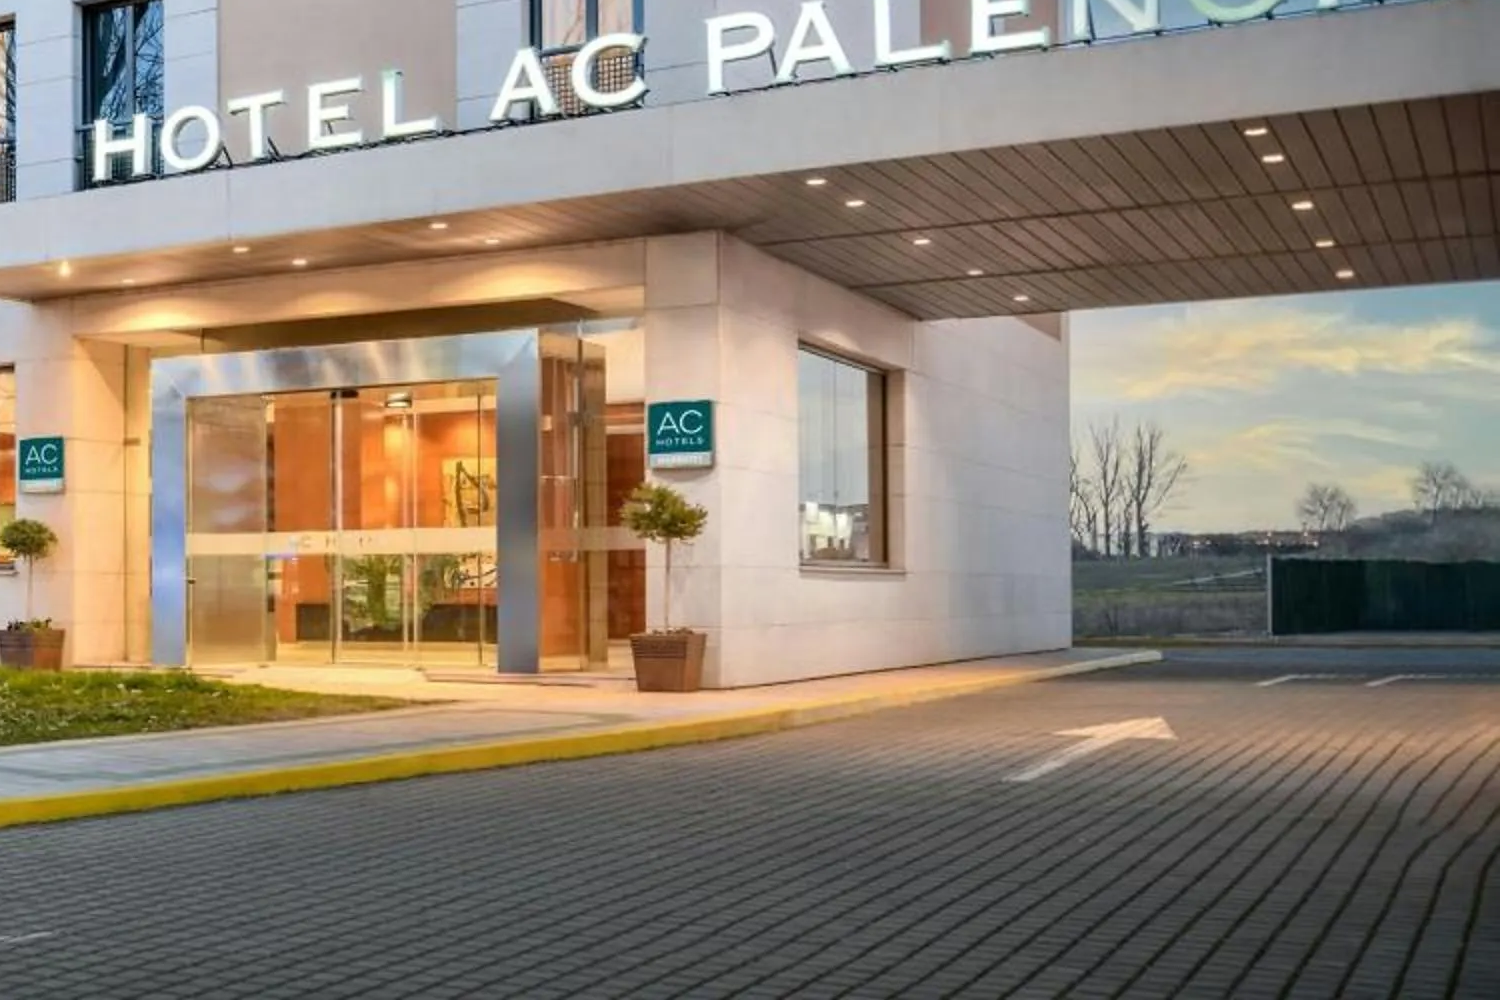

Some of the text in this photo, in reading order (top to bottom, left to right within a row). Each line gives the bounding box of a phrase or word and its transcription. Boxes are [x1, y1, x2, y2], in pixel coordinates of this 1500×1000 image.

[91, 68, 438, 182] HOTEL
[489, 31, 649, 122] AC
[656, 409, 704, 436] AC
[24, 443, 59, 466] AC
